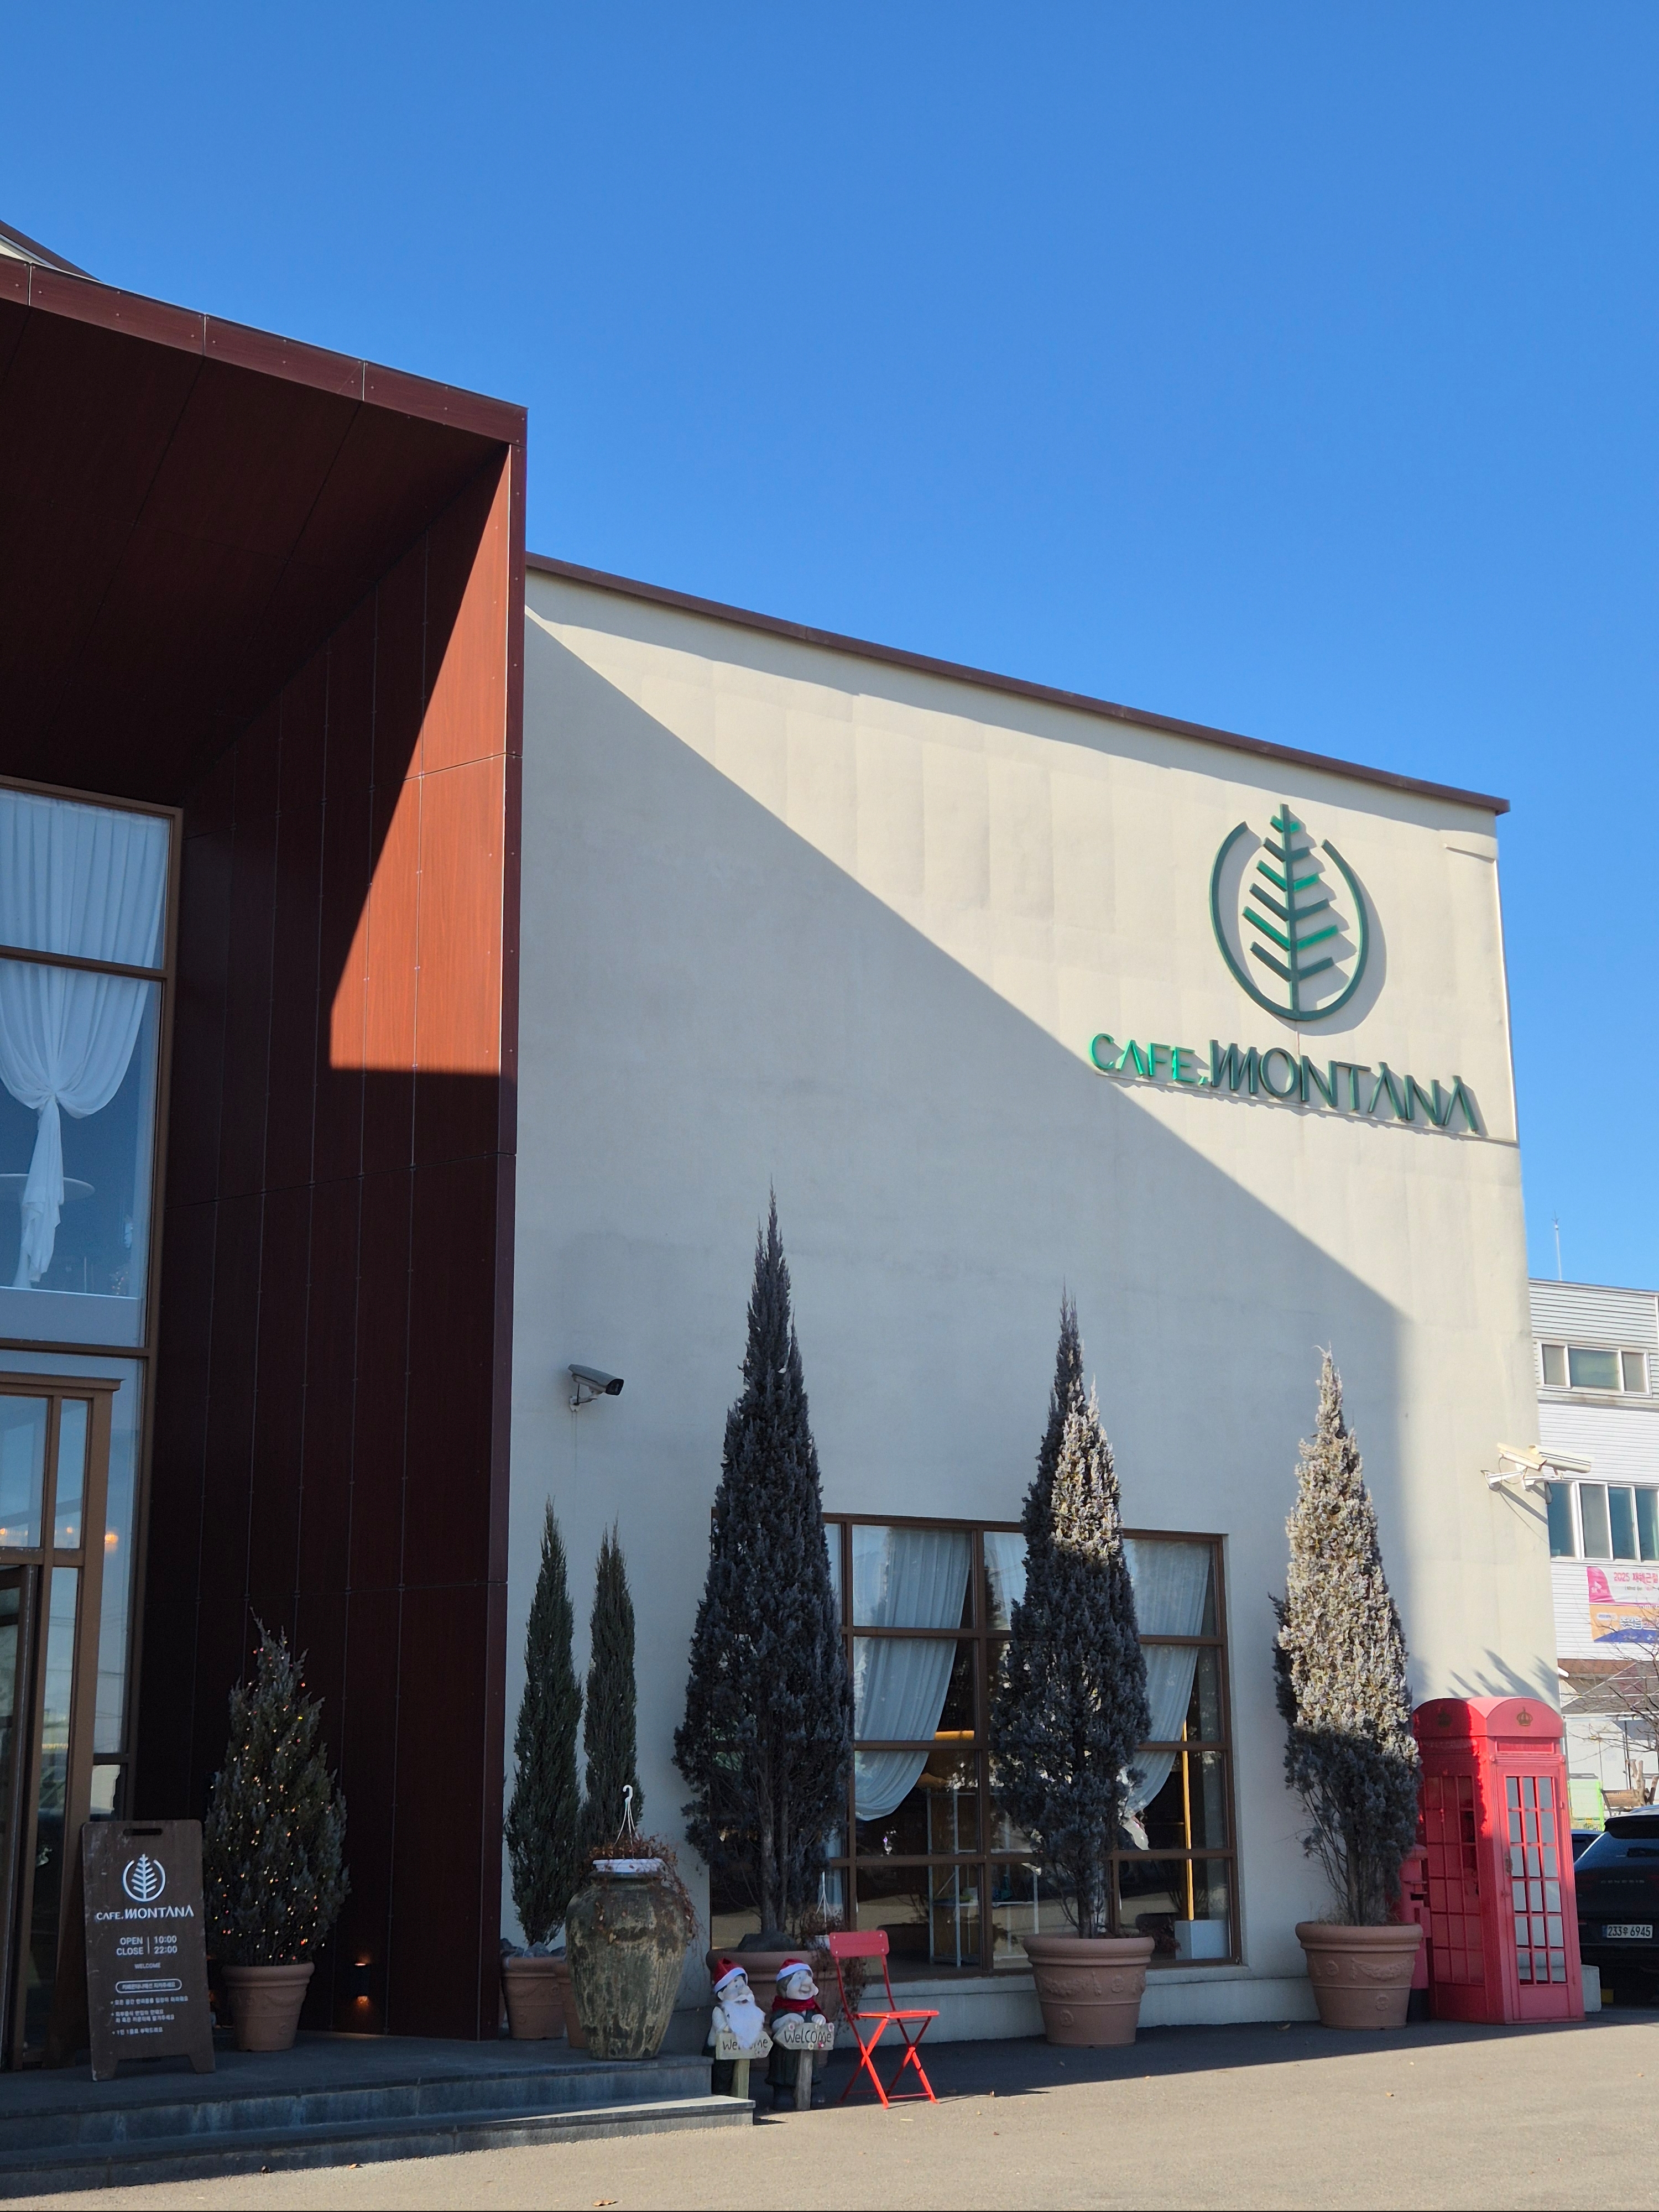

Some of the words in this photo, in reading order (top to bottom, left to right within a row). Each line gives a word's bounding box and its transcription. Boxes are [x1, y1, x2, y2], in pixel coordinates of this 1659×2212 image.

[1613, 1572, 1630, 1582] 2025
[1608, 1926, 1628, 1936] 233우
[1630, 1926, 1651, 1937] 6945
[119, 1936, 143, 1945] OPEN
[154, 1935, 177, 1944] 10:00
[116, 1947, 144, 1955] CLOSE
[154, 1945, 178, 1954] 22:00
